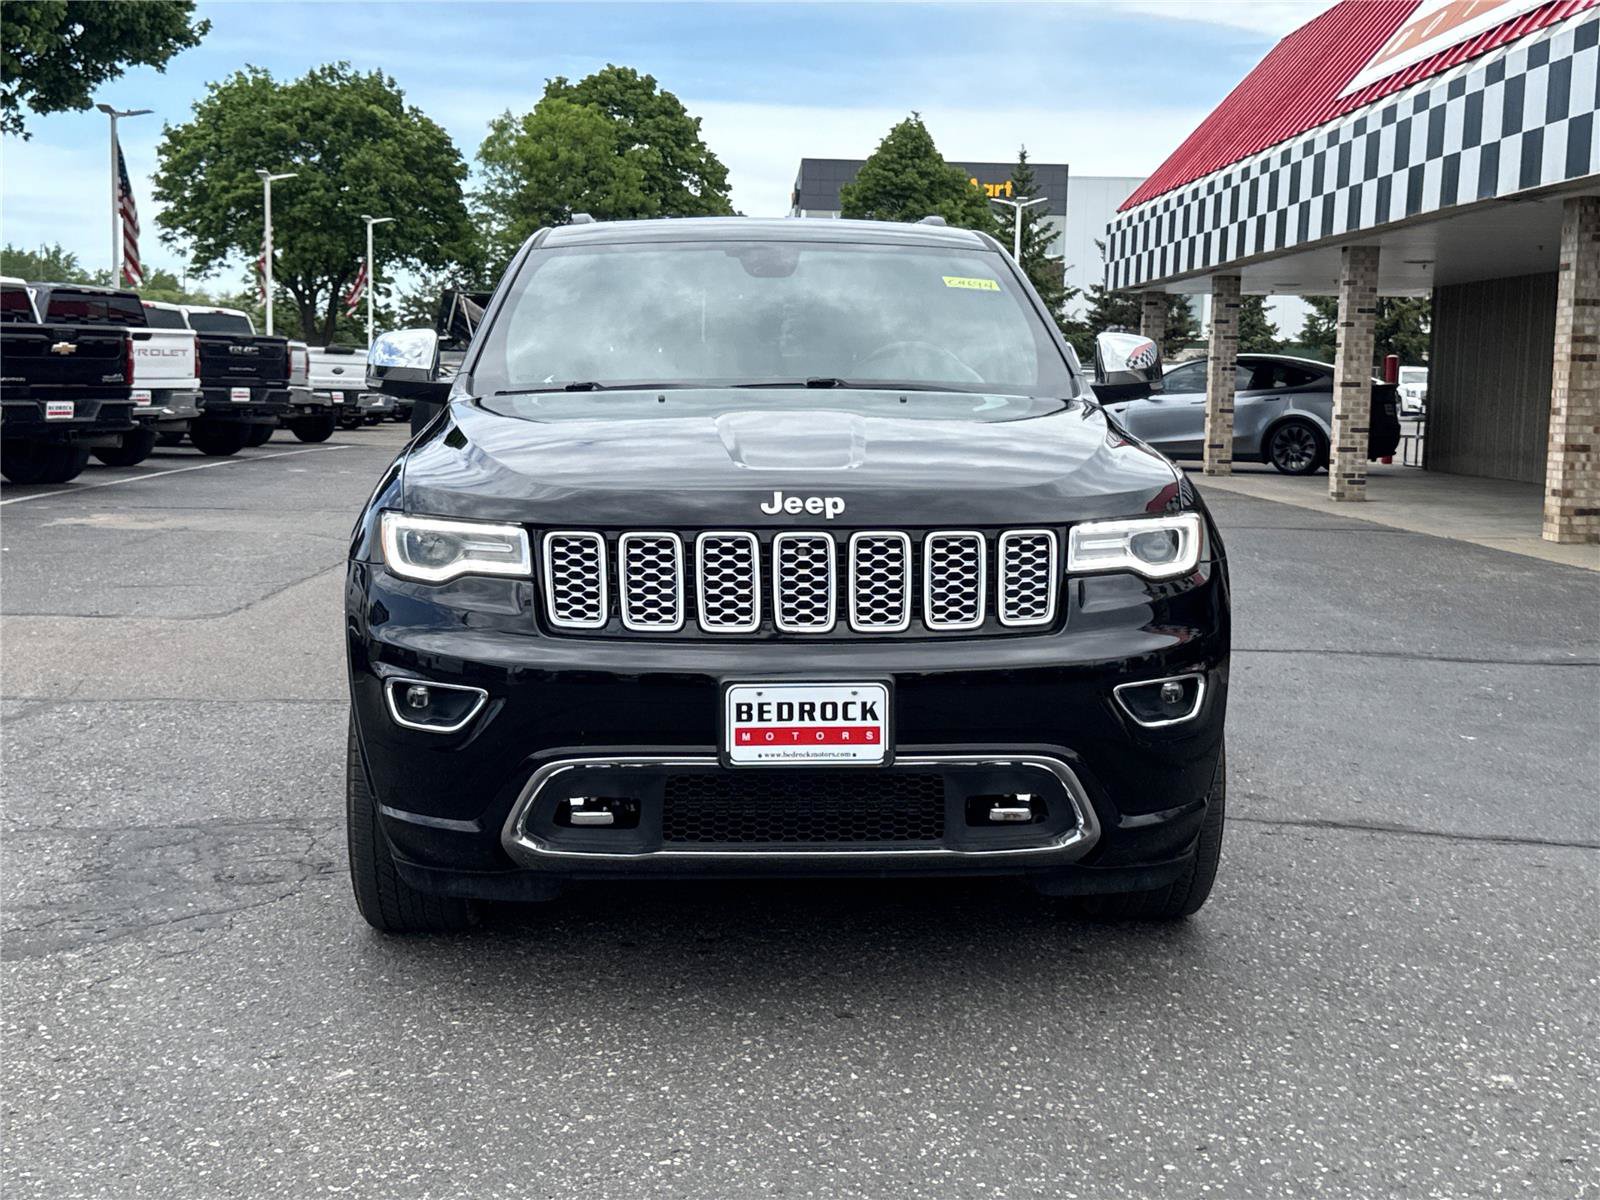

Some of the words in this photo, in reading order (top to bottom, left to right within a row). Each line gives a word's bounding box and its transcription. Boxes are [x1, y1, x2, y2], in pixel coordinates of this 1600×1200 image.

[760, 491, 845, 519] Jeep
[735, 701, 879, 722] BEDROCK
[741, 731, 874, 741] MOTORS
